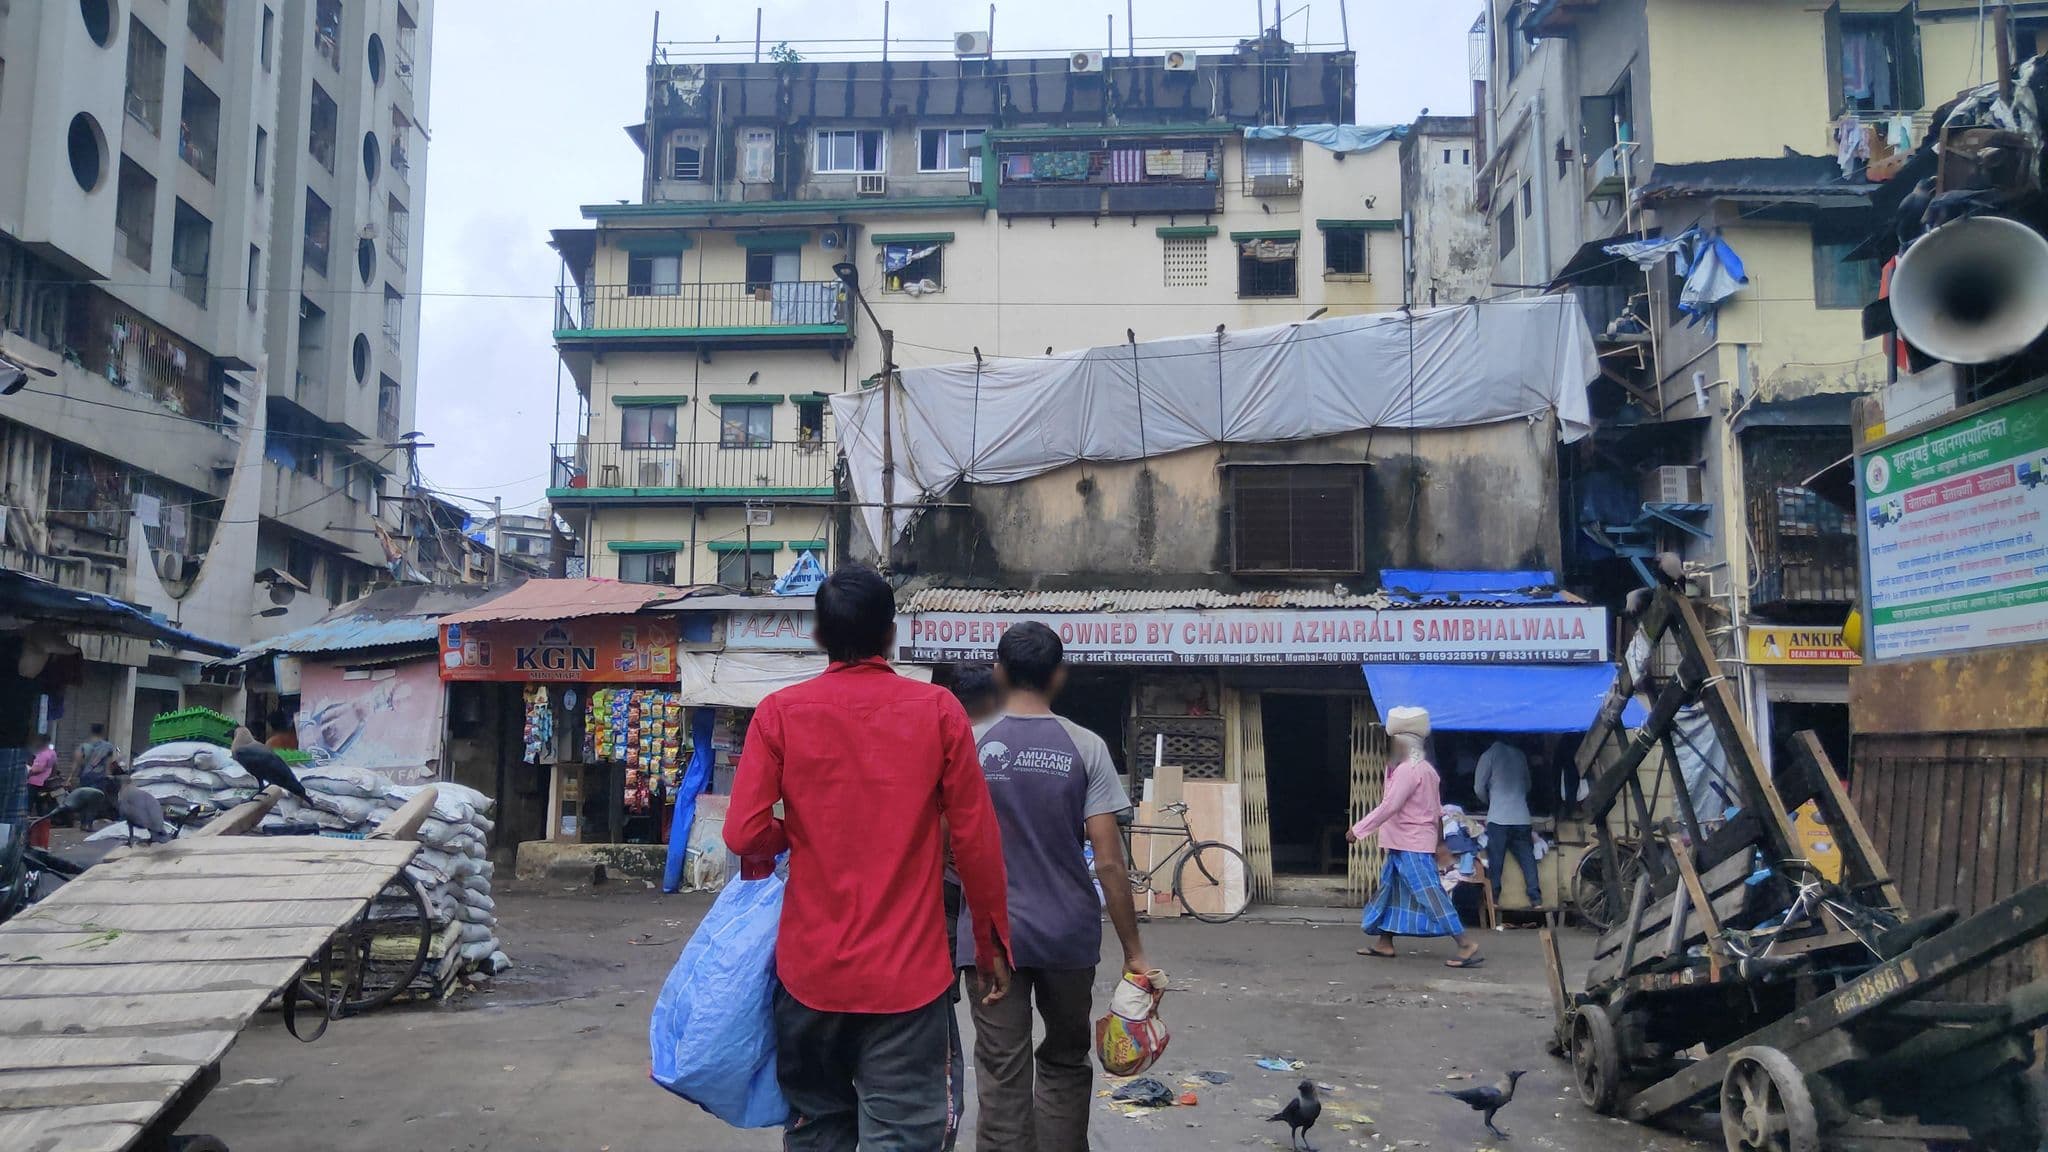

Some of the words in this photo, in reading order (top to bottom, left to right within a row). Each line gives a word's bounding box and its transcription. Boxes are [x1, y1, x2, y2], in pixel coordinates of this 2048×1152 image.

[1931, 417, 2007, 456] महानगरपालिका
[910, 619, 1012, 643] PROPERT
[1060, 622, 1137, 645] OWNED
[1148, 622, 1172, 645] BY
[1182, 621, 1282, 645] CHANDNI
[1292, 619, 1403, 644] AZHARALI
[1412, 616, 1586, 643] SAMBHALWALA
[1789, 632, 1842, 647] ANKUR
[514, 646, 598, 671] KGN
[1086, 650, 1112, 662] अली
[1179, 654, 1195, 664] 106
[1205, 654, 1219, 663] 108
[1222, 653, 1250, 665] Masjid
[1254, 653, 1282, 663] Street,
[1285, 652, 1338, 663] Mumbai-400
[1363, 652, 1396, 662] Contact
[1017, 750, 1072, 765] AMULAKH
[1013, 759, 1071, 772] AMICHAND
